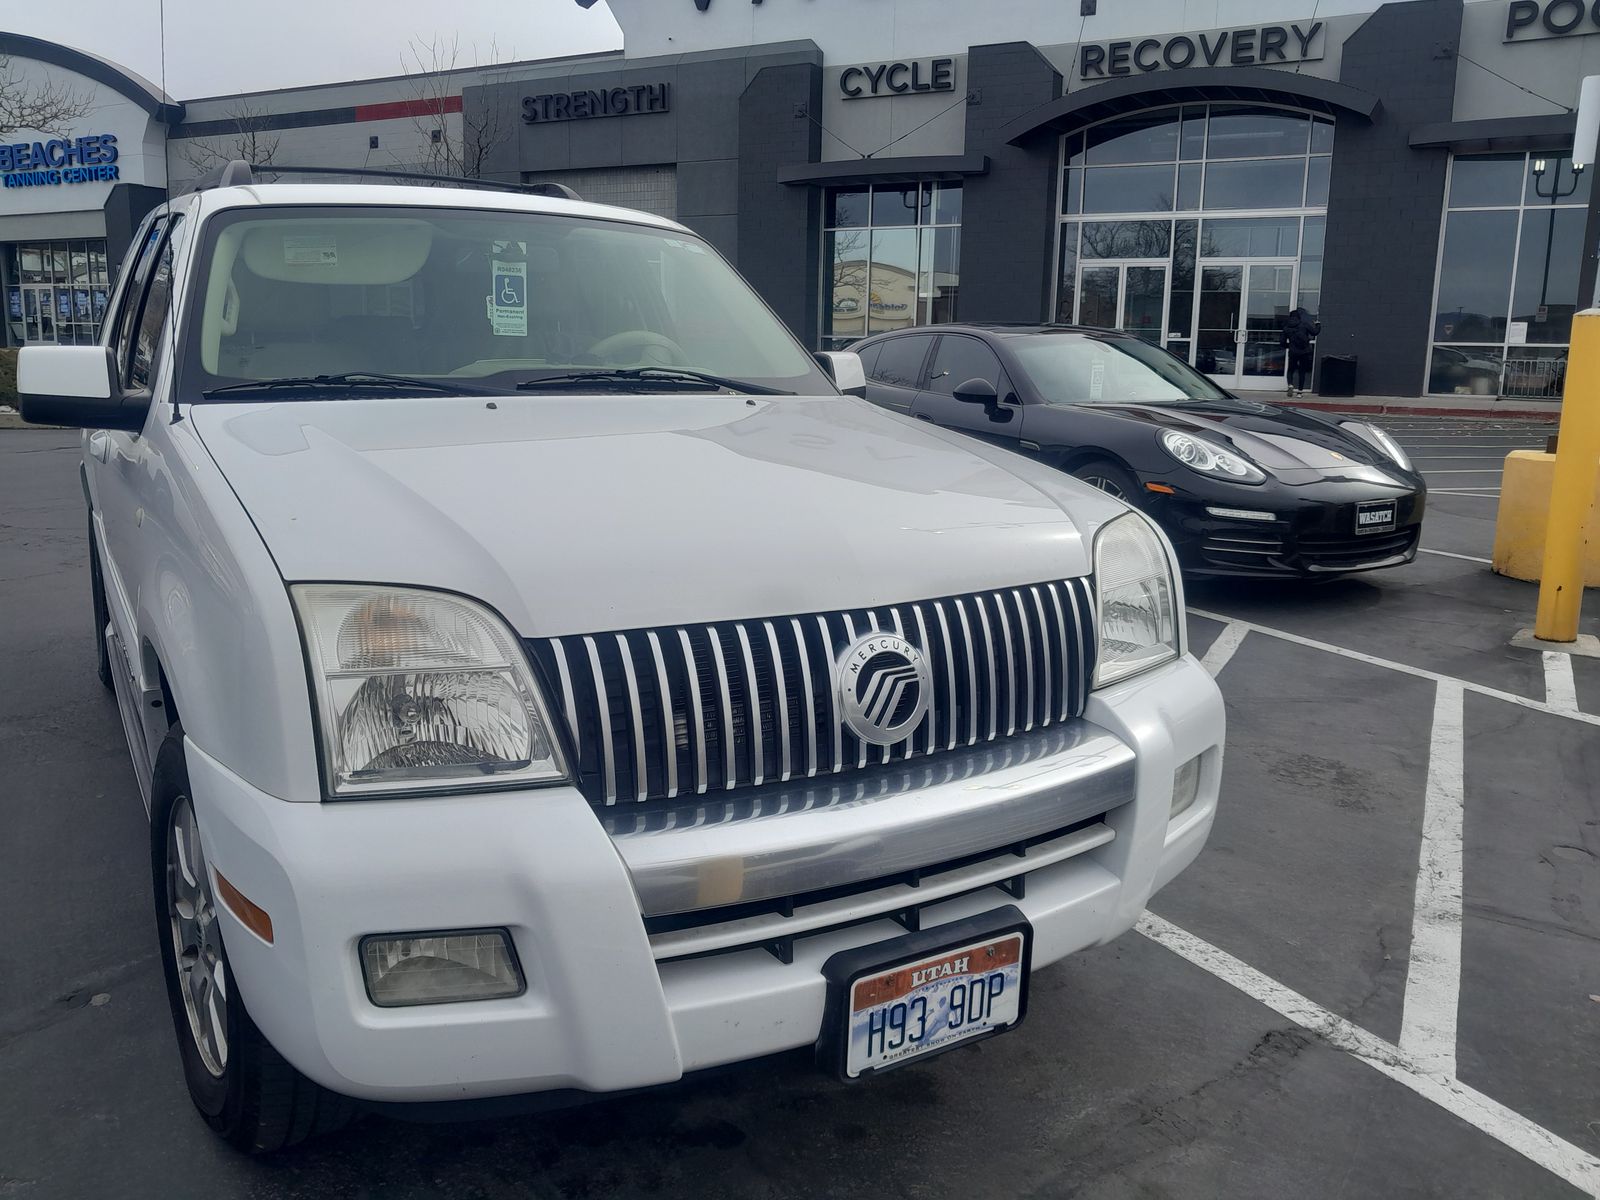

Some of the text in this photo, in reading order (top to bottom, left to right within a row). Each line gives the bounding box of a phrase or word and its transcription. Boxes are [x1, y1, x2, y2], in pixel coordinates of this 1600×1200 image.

[1506, 0, 1600, 38] PO
[1080, 22, 1322, 77] RECOVERY
[840, 58, 952, 97] CYCLE
[521, 83, 668, 122] STRENGTH
[0, 134, 119, 171] BEACHES
[0, 164, 119, 188] TANNING CENTER
[1359, 510, 1392, 524] WASATCH
[849, 639, 919, 674] MERCURY
[911, 956, 970, 988] UTAH
[867, 972, 1005, 1058] H93 9DP
